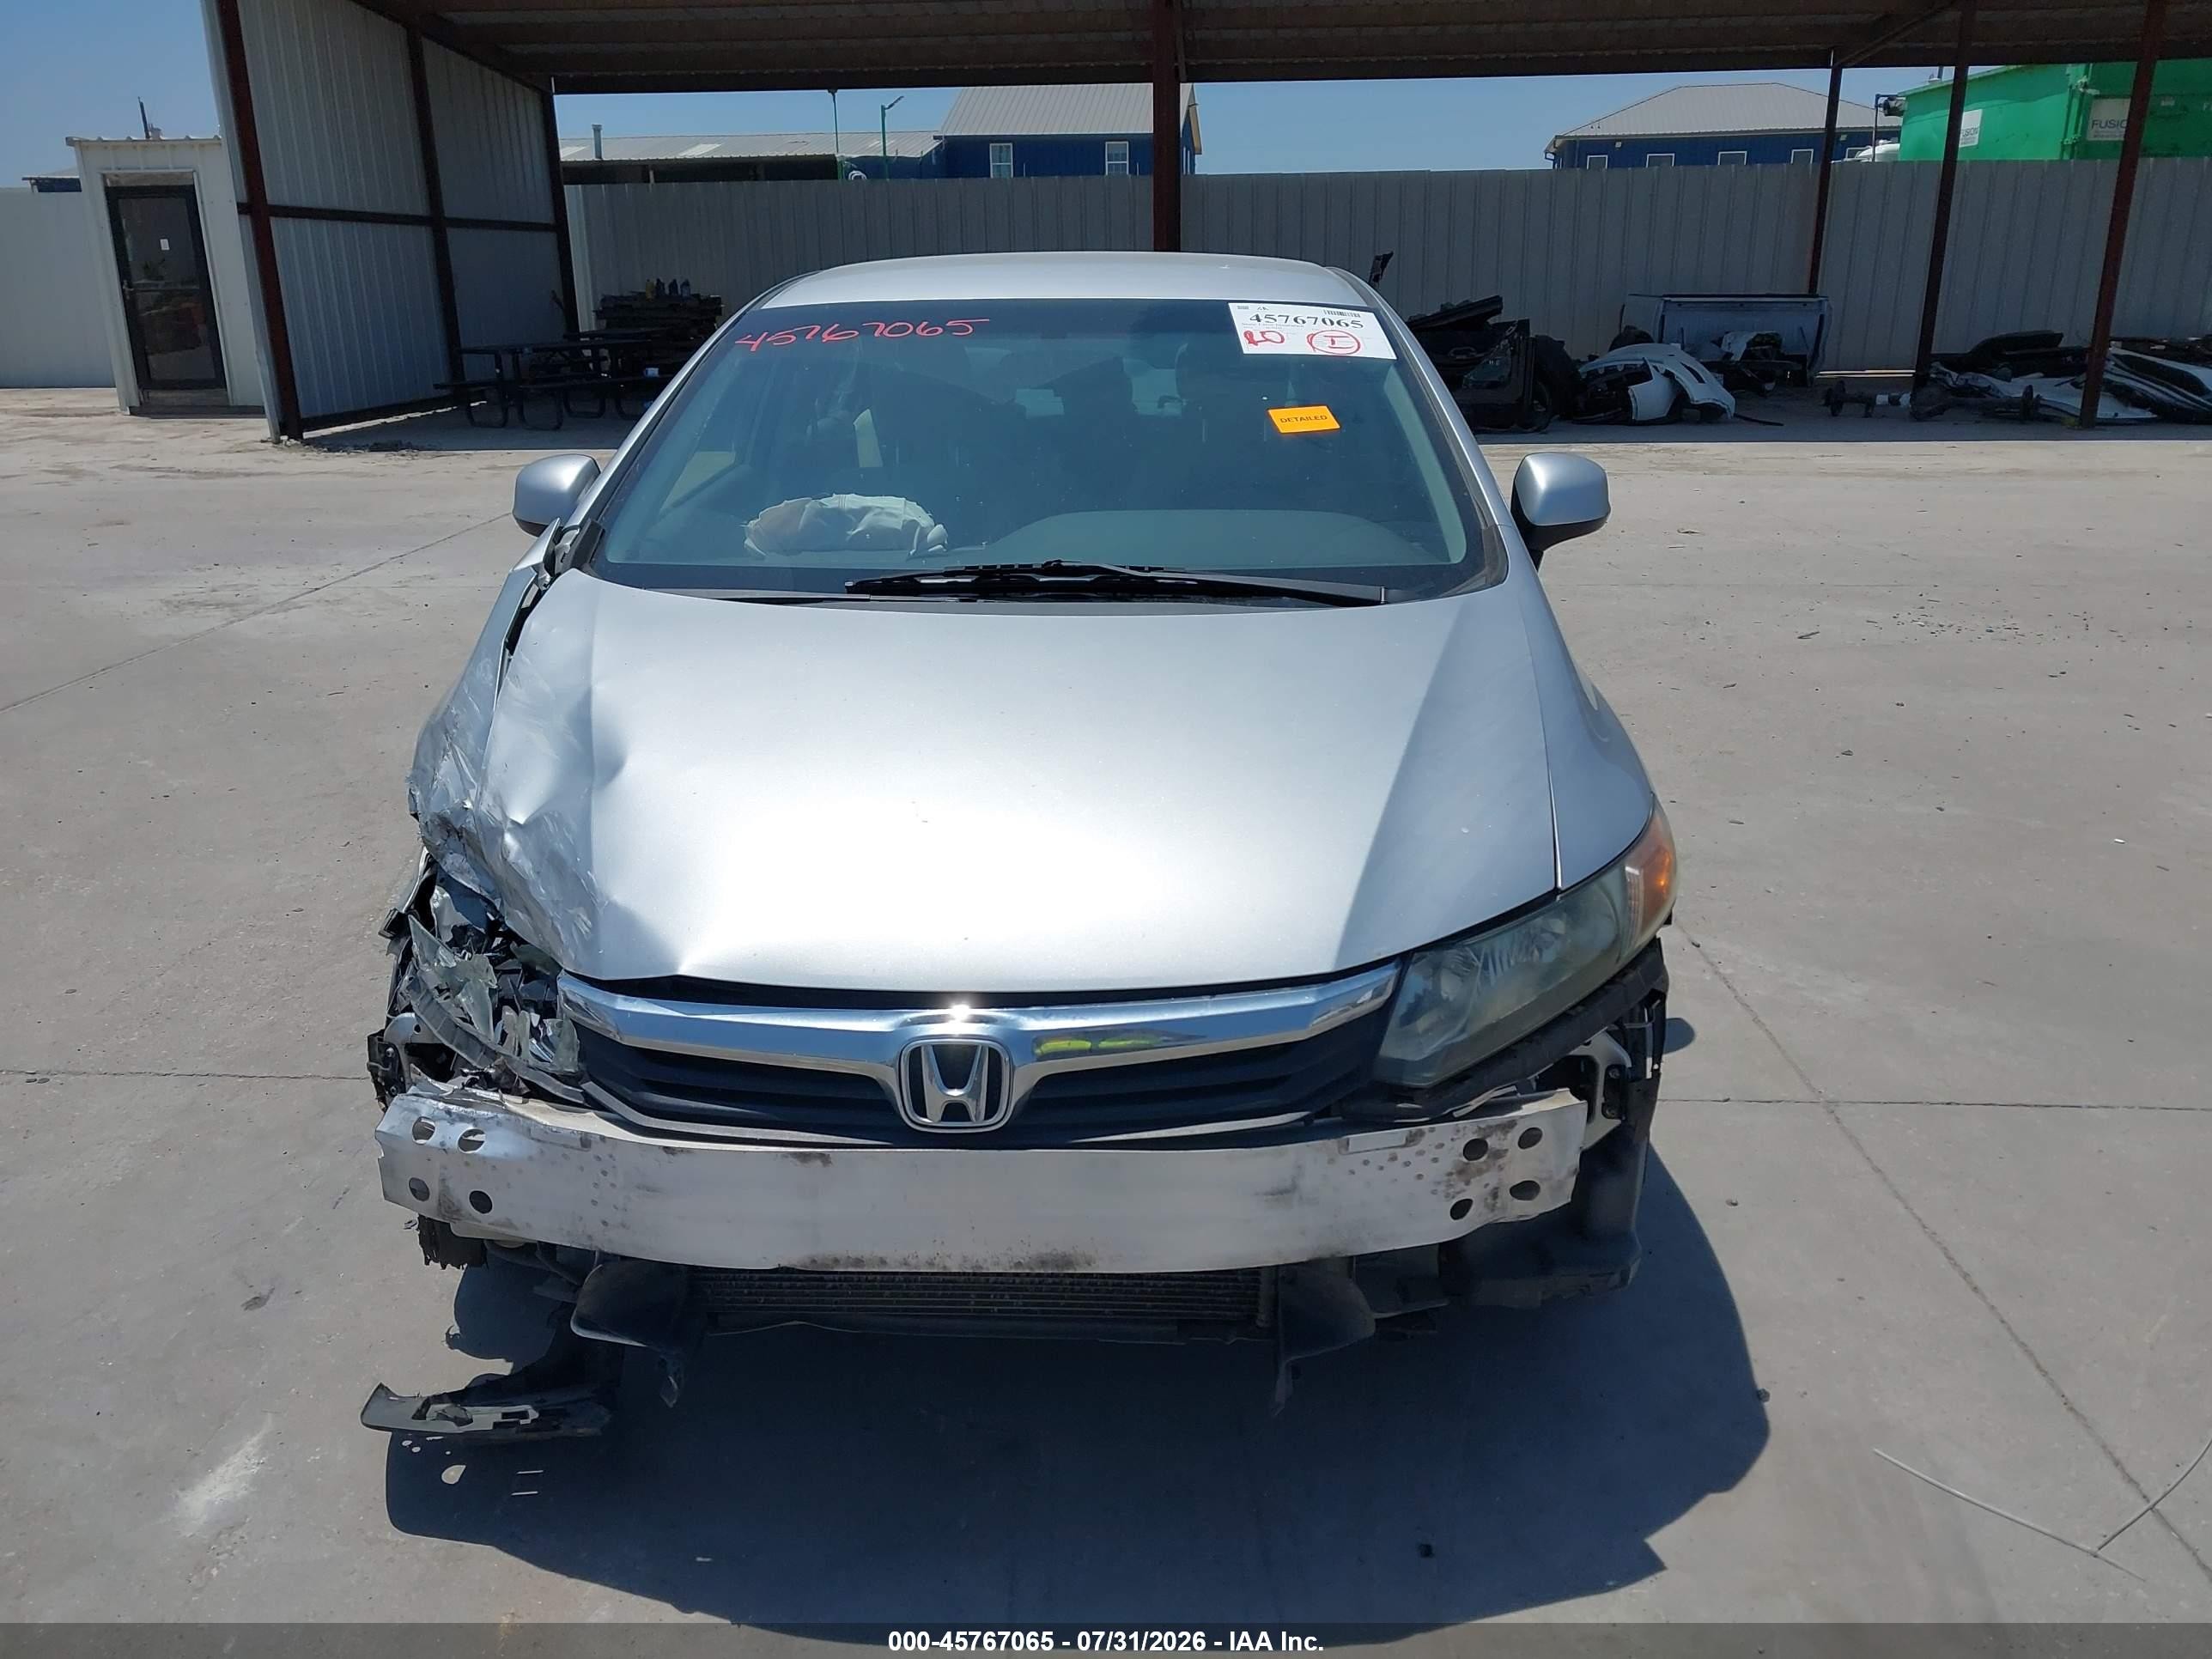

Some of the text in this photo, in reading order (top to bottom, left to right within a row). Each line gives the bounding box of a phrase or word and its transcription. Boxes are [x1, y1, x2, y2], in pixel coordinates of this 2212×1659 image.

[2091, 118, 2128, 130] FUSIO
[1249, 313, 1364, 329] 45767065
[1279, 415, 1328, 423] DETAILED
